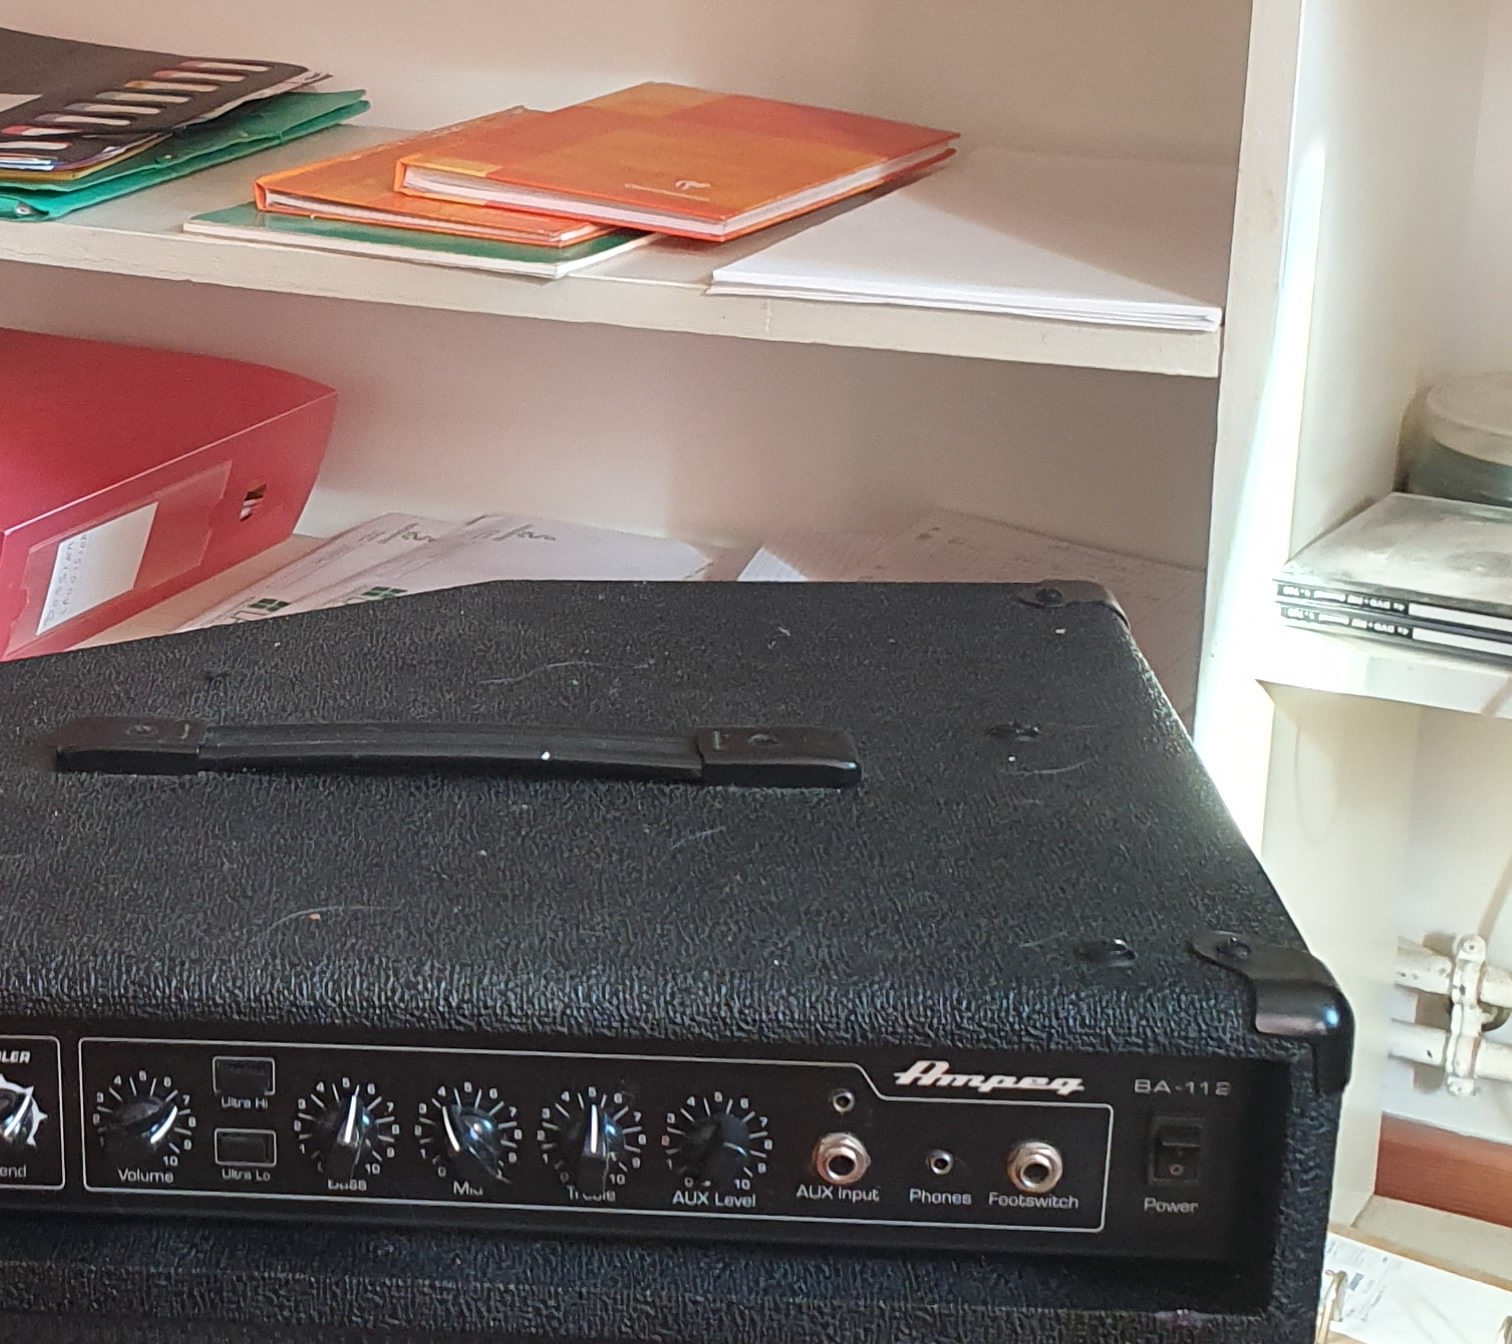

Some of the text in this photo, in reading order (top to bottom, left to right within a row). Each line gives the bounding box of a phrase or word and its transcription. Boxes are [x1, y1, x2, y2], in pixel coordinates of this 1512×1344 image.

[113, 1075, 122, 1085] 4
[893, 1059, 1086, 1097] Ampeg
[316, 1082, 325, 1093] 4
[438, 1086, 447, 1097] 4
[182, 1095, 190, 1105] 7
[561, 1091, 570, 1102] 4
[687, 1096, 696, 1107] 4
[387, 1102, 394, 1112] 7
[509, 1106, 517, 1117] 7
[633, 1111, 641, 1122] 7
[759, 1116, 768, 1127] 7
[163, 1156, 178, 1167] 10
[365, 1163, 380, 1175] 10
[117, 1168, 174, 1183] Volume
[222, 1168, 271, 1182] Ultra Lo
[609, 1173, 626, 1185] 10
[735, 1179, 751, 1191] 10
[672, 1190, 757, 1207] AUX Level
[796, 1183, 880, 1205] AUX Input
[909, 1188, 972, 1205] Phones
[988, 1192, 1080, 1210] Footswitch
[1144, 1197, 1199, 1215] Power
